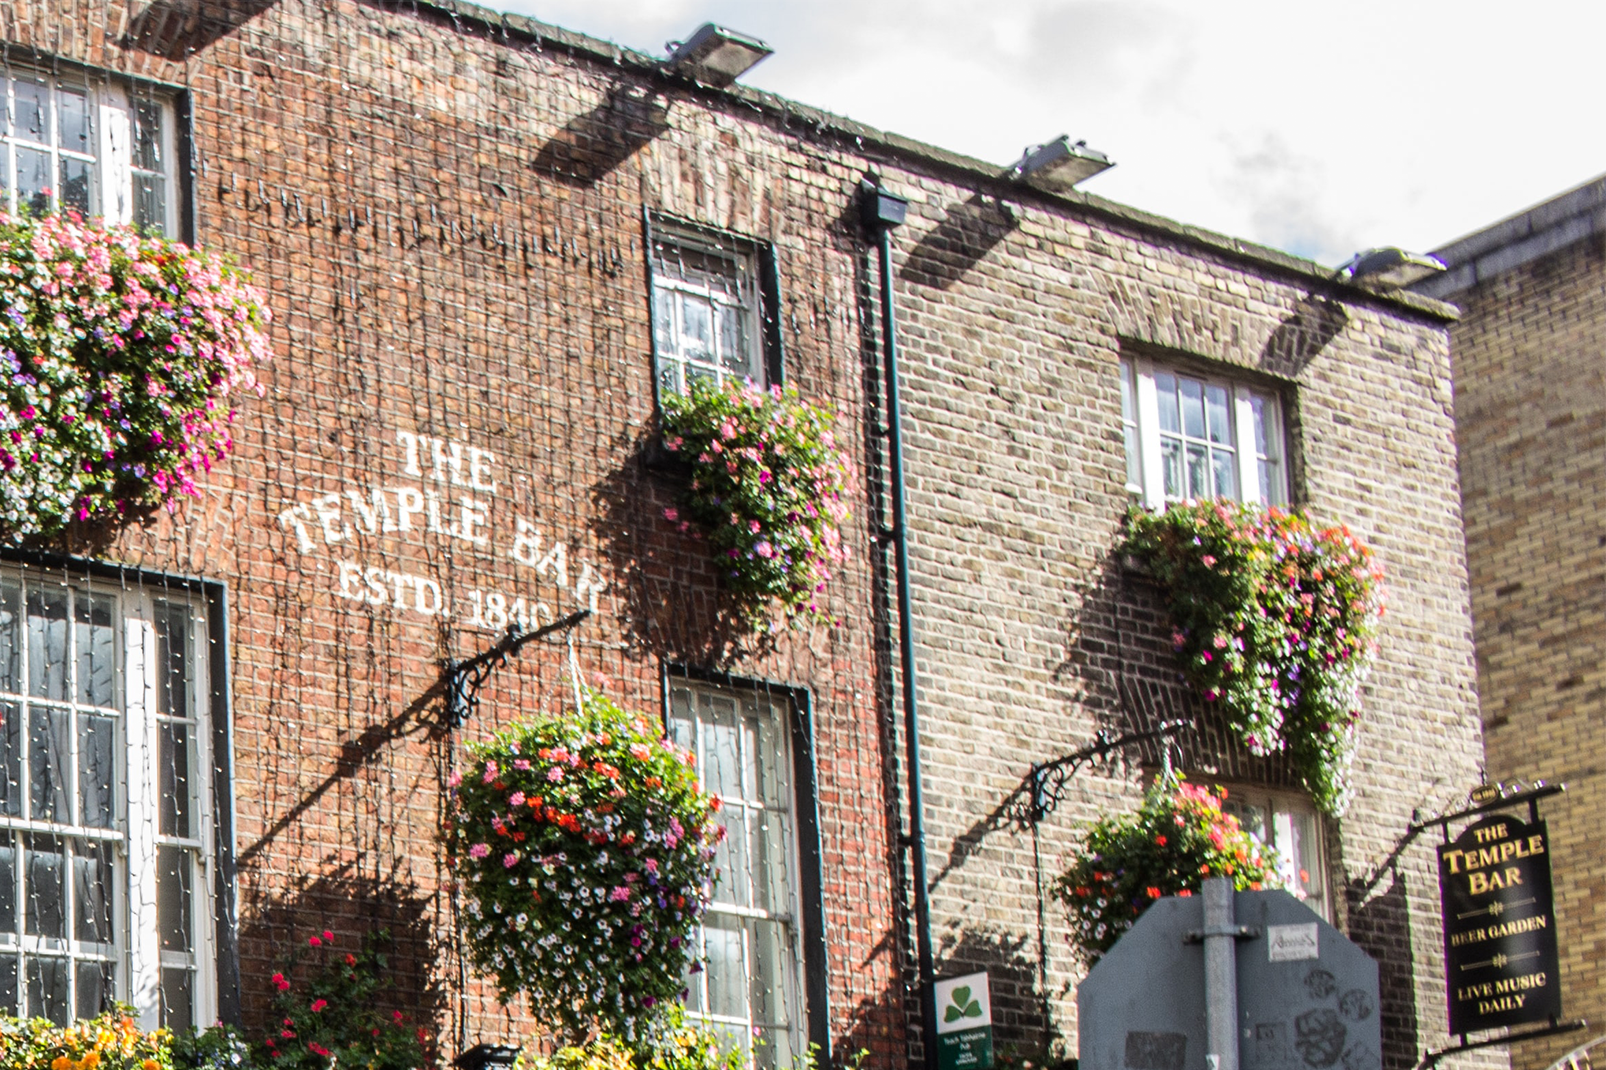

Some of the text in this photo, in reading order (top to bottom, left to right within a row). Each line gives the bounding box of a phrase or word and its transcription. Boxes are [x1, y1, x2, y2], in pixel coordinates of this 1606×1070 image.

[396, 431, 497, 494] THE
[278, 487, 608, 613] TEMPLE BAR
[336, 560, 451, 617] ESTD.
[1473, 823, 1508, 843] THE
[1443, 834, 1545, 875] TEMPLE
[1468, 866, 1524, 896] BAR
[1451, 914, 1547, 947] BEER GARDEN
[1457, 972, 1547, 1002] LIVE MUSIC
[1478, 992, 1527, 1015] DAILY
